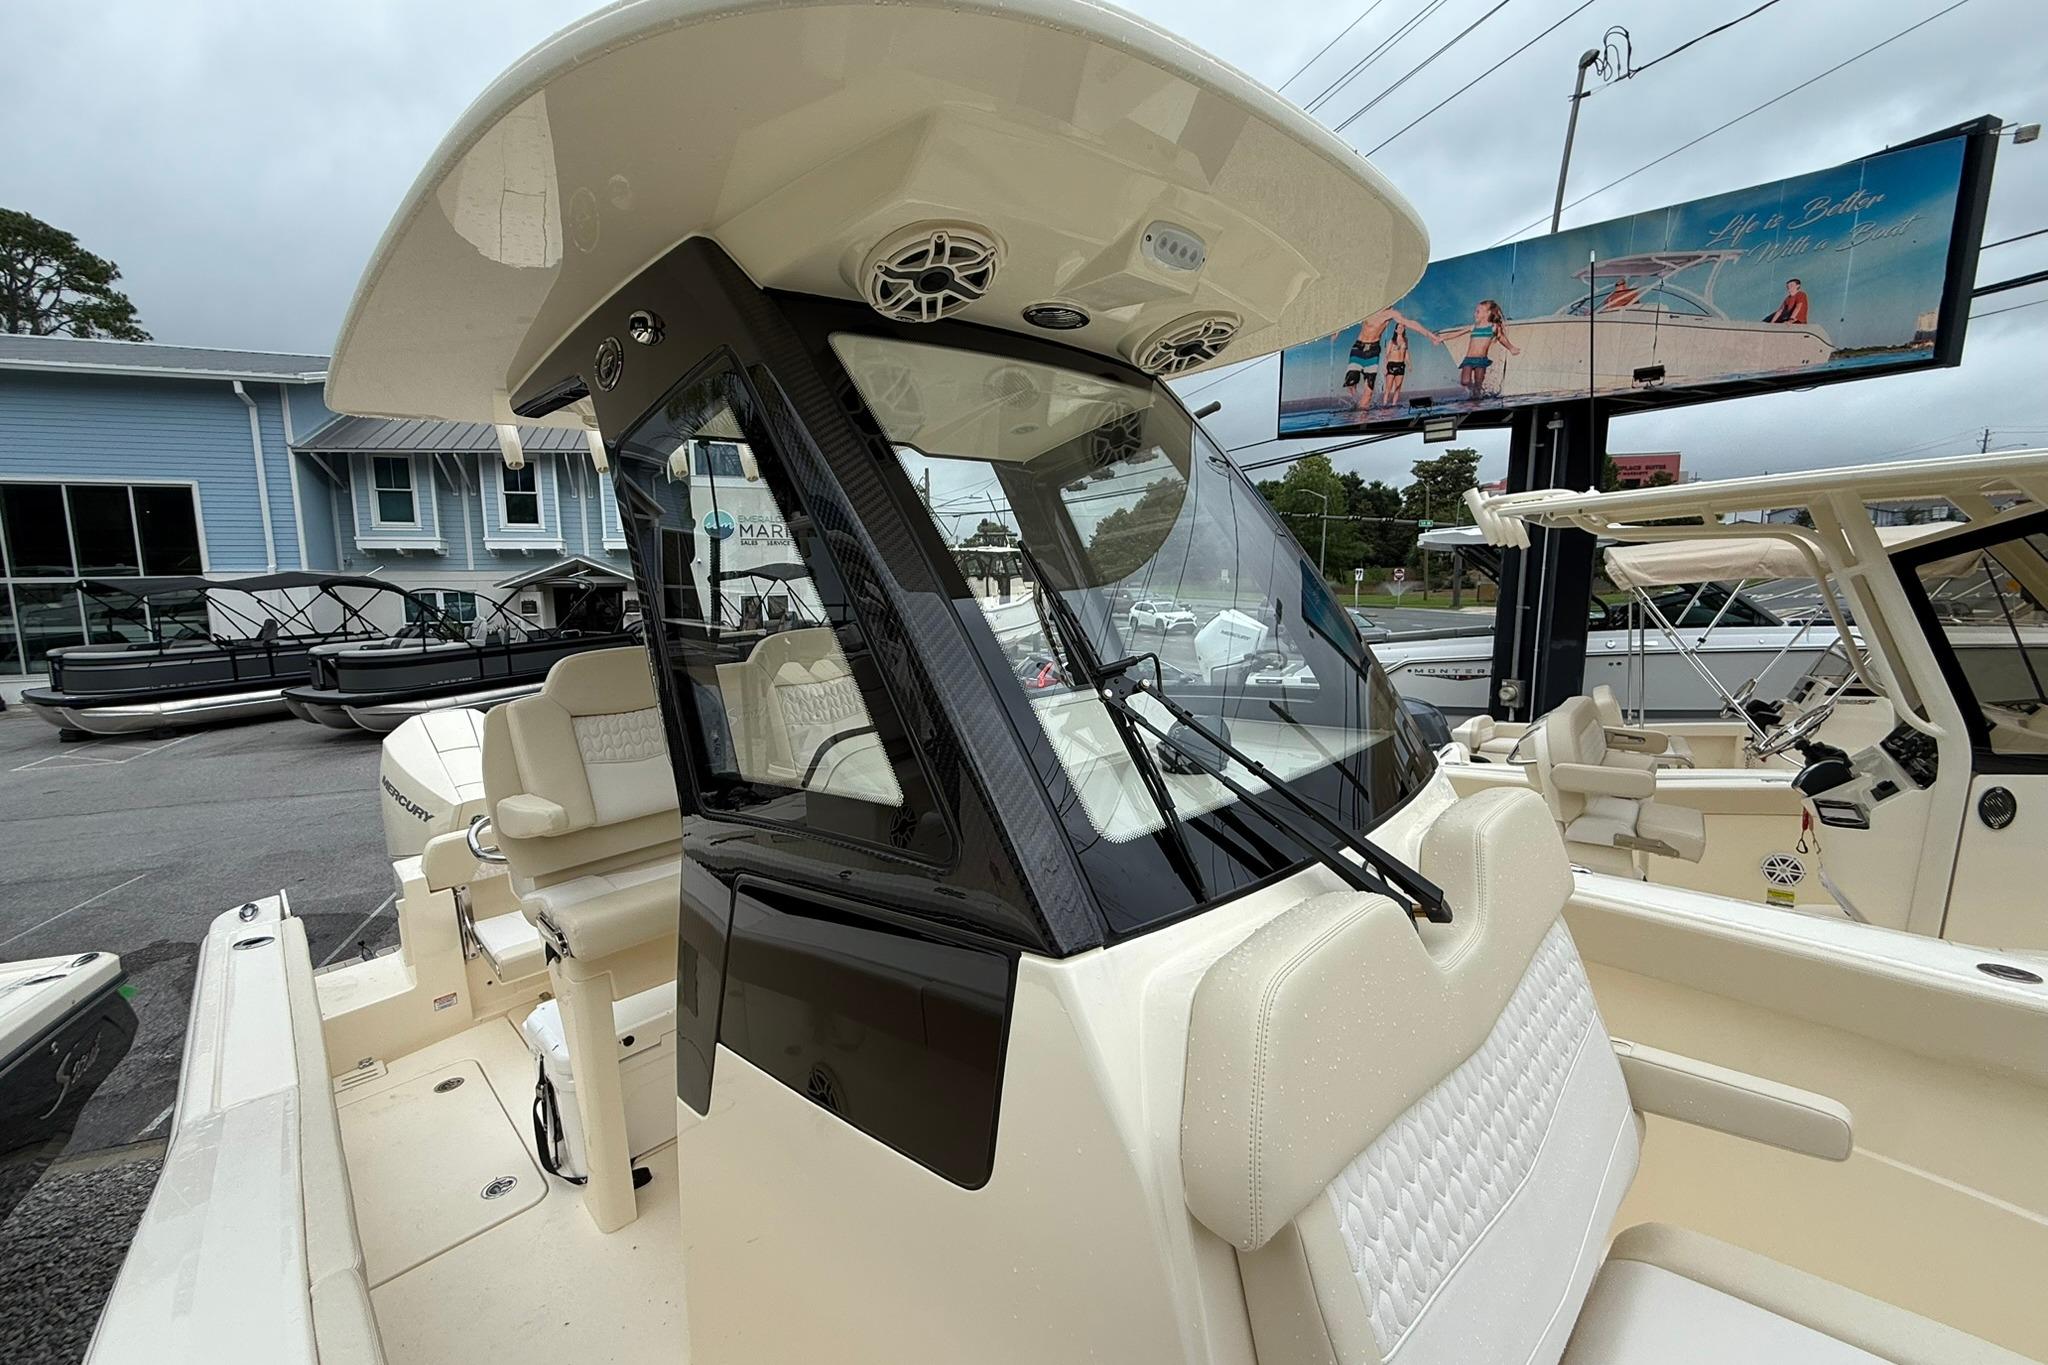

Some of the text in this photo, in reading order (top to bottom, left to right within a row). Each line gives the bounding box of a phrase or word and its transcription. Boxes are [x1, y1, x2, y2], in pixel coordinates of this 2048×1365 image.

[1706, 188, 1886, 247] Life is Better
[1749, 214, 1926, 265] With a Boat
[382, 775, 435, 822] MERCURY
